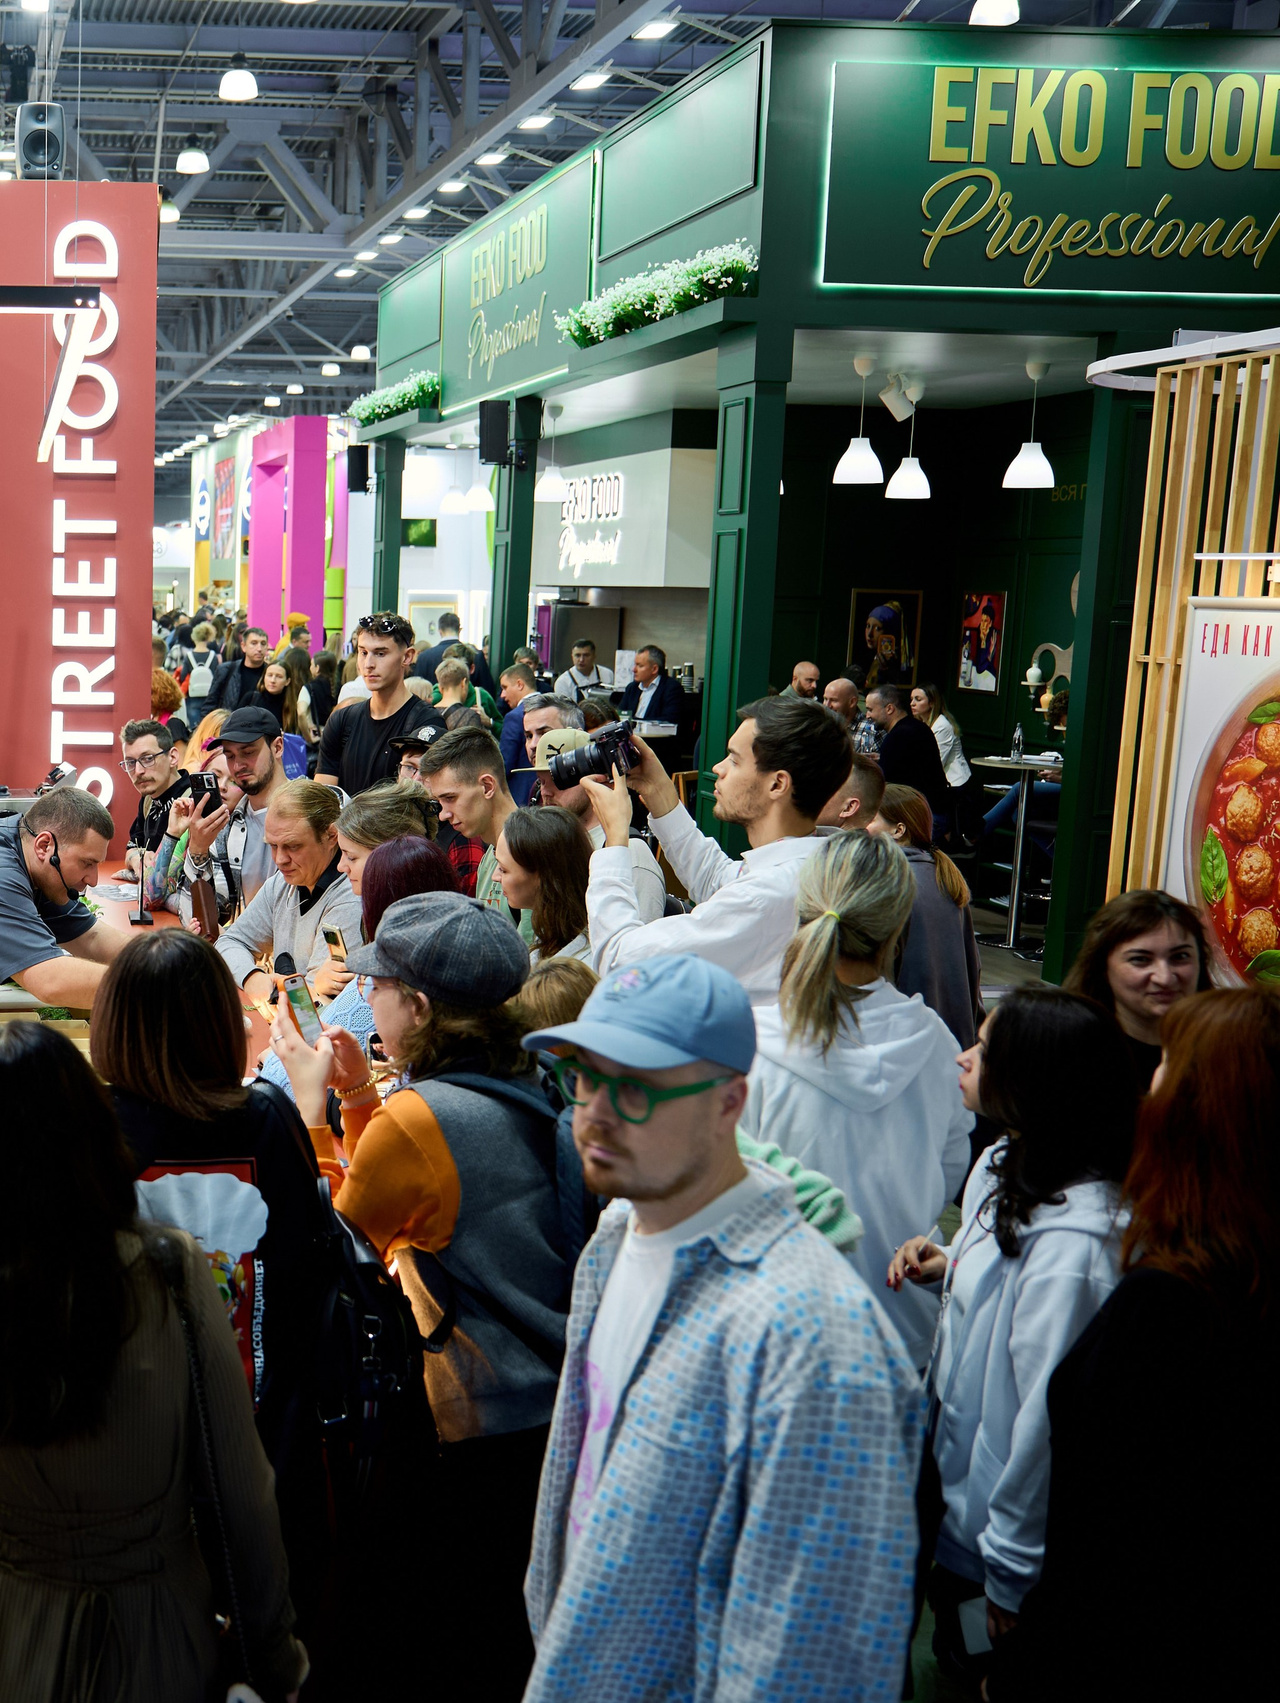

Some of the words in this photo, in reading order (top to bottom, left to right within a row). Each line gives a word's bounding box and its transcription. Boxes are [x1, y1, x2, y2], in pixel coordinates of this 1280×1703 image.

[928, 66, 1108, 167] EFKO
[471, 230, 506, 309] EFKO
[507, 203, 548, 290] FOOD
[52, 219, 119, 475] FOOD
[468, 291, 547, 382] Professional
[590, 474, 622, 520] FOOD
[1201, 623, 1230, 658] ЕДА
[1241, 624, 1273, 657] КАК
